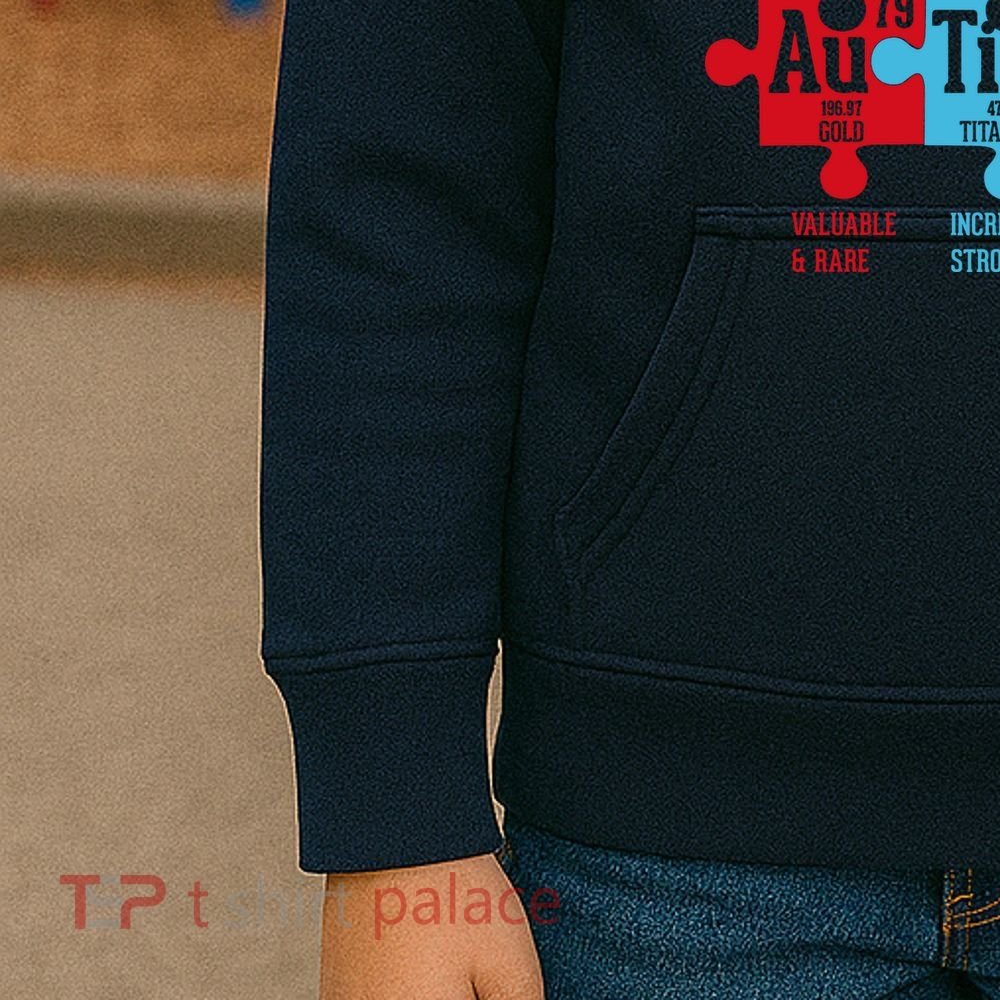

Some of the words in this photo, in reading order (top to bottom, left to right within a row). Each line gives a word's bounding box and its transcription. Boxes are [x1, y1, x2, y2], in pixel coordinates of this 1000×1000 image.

[769, 9, 868, 94] Au
[932, 9, 999, 94] Ti
[821, 100, 862, 116] 196.97
[818, 120, 864, 142] GOLD
[791, 211, 896, 237] VALUABLE
[792, 248, 805, 273] &
[814, 248, 869, 273] RARE
